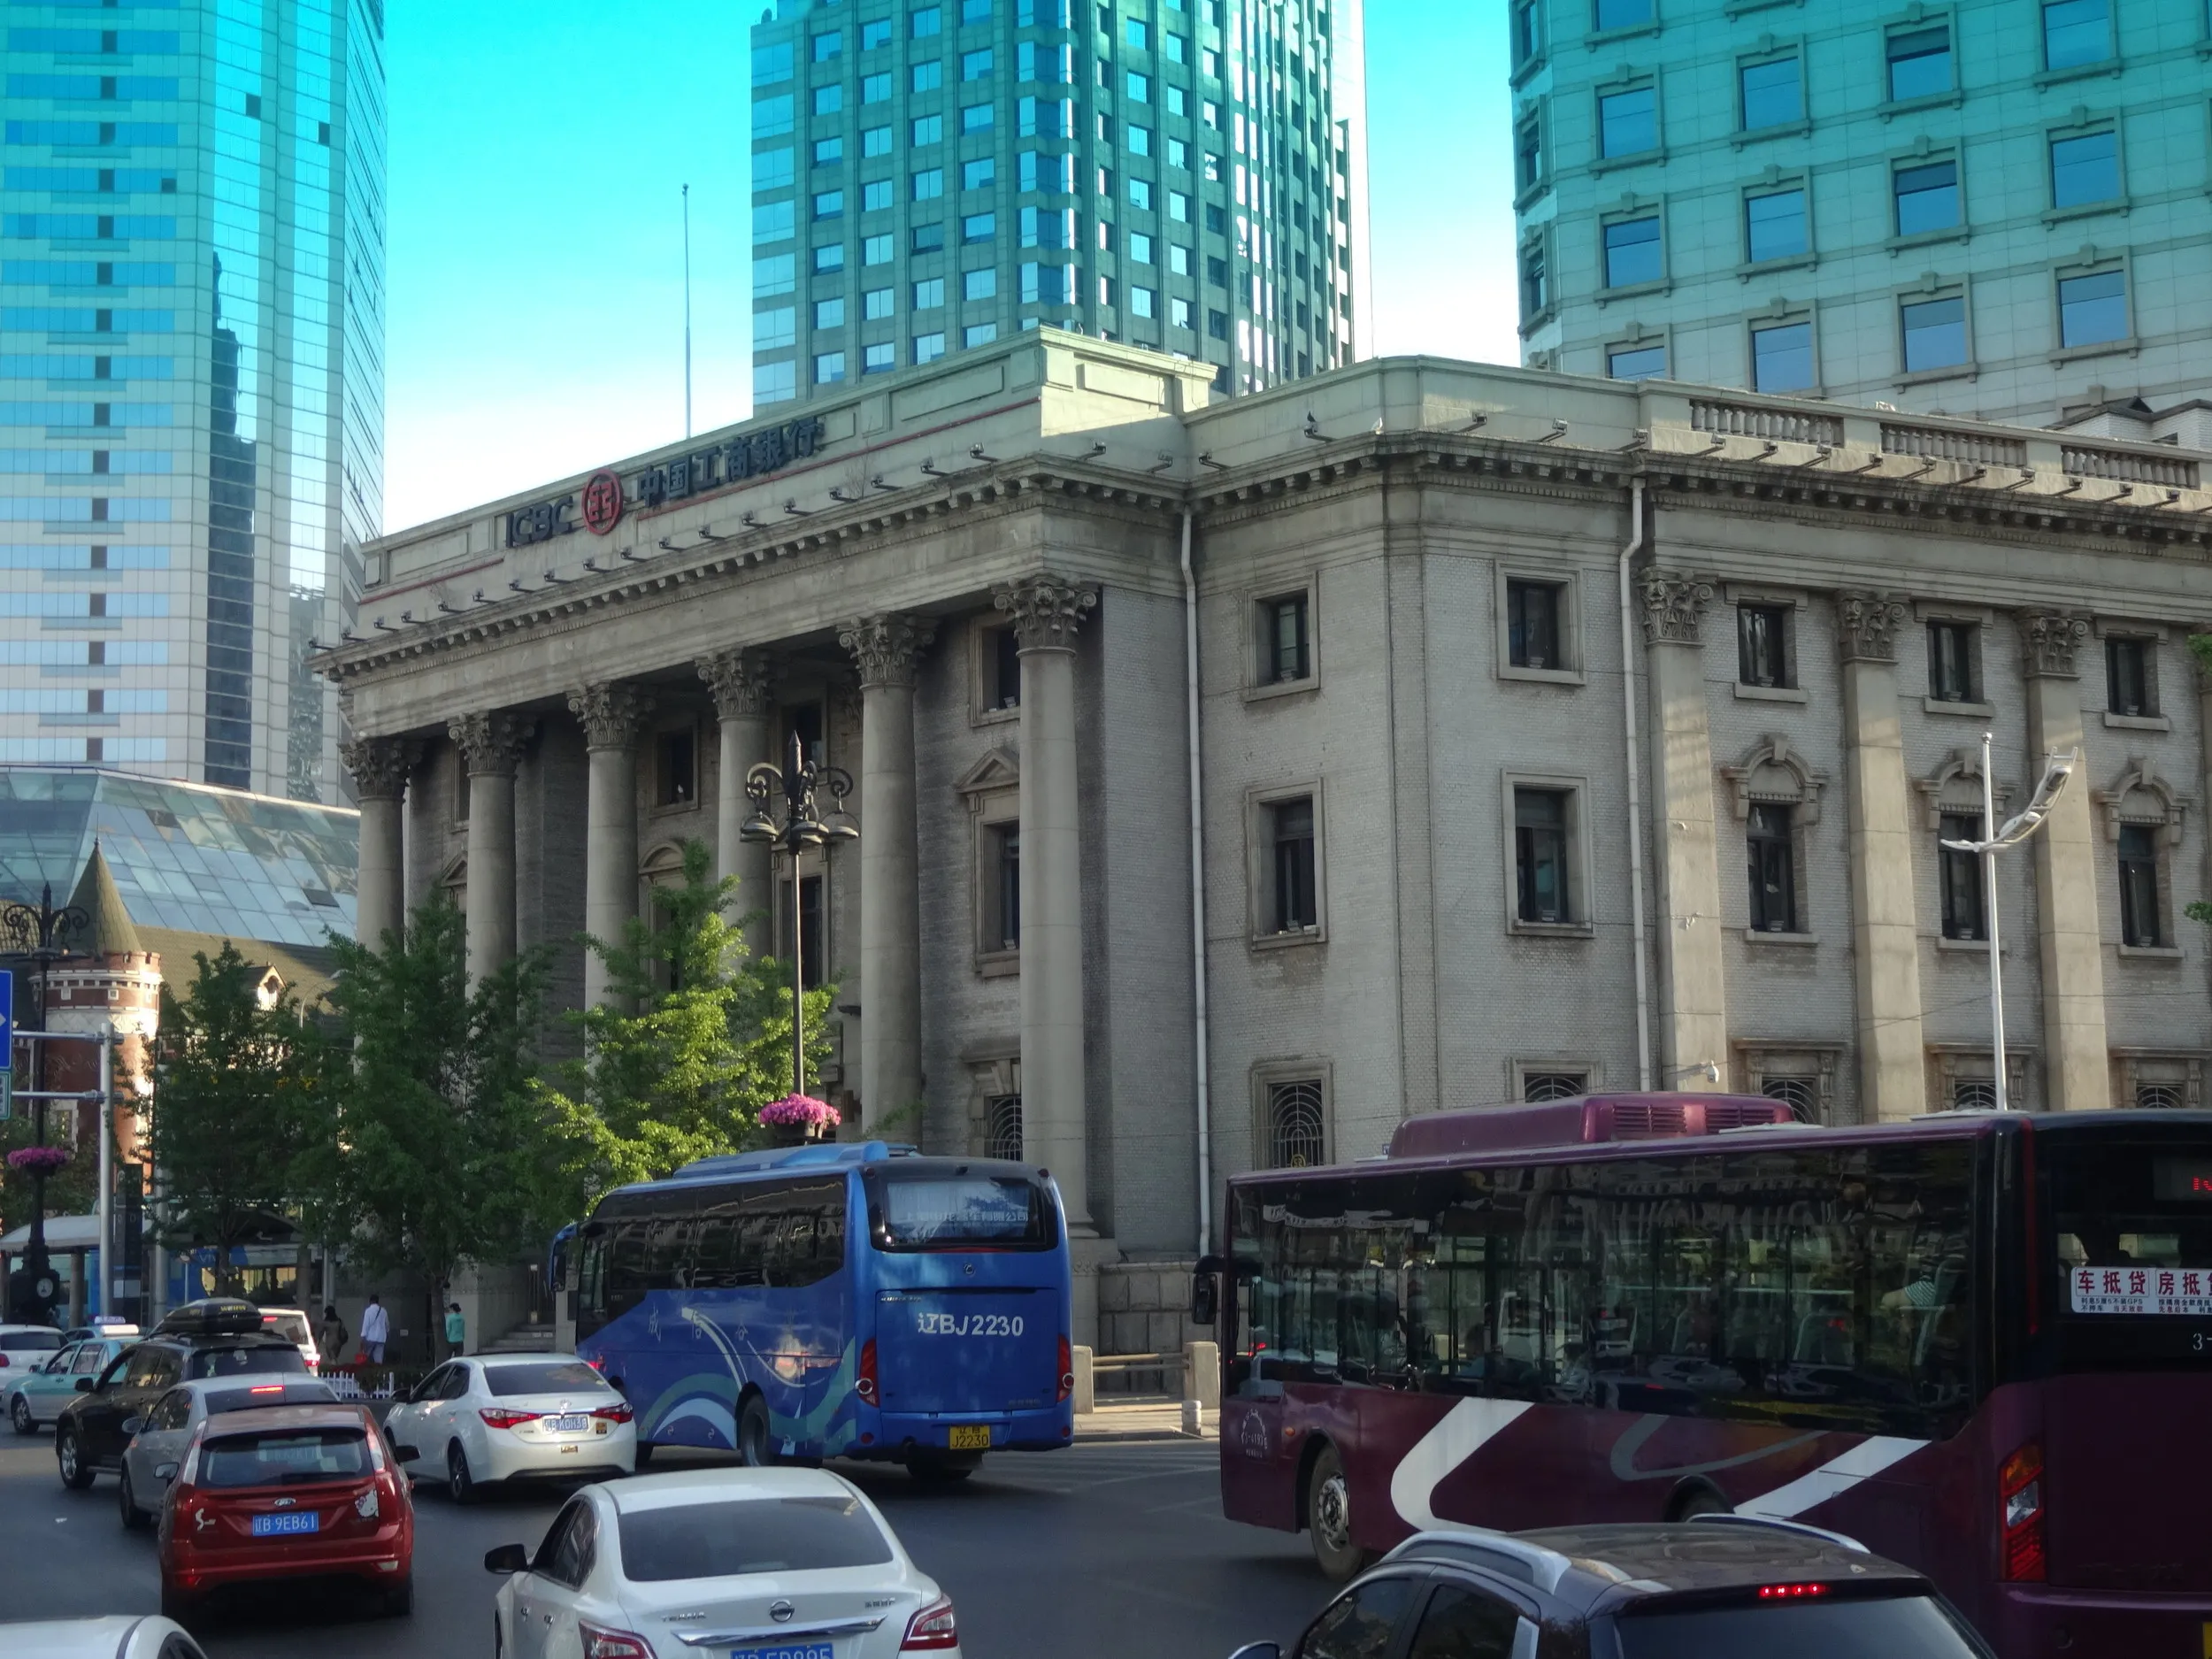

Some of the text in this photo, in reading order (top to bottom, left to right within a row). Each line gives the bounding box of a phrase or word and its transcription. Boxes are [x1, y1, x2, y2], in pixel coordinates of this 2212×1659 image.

[505, 496, 573, 548] ICBC
[2078, 1270, 2146, 1294] 车抵贷
[918, 1312, 1025, 1337] 辽BJ2230
[951, 1434, 988, 1448] J2230
